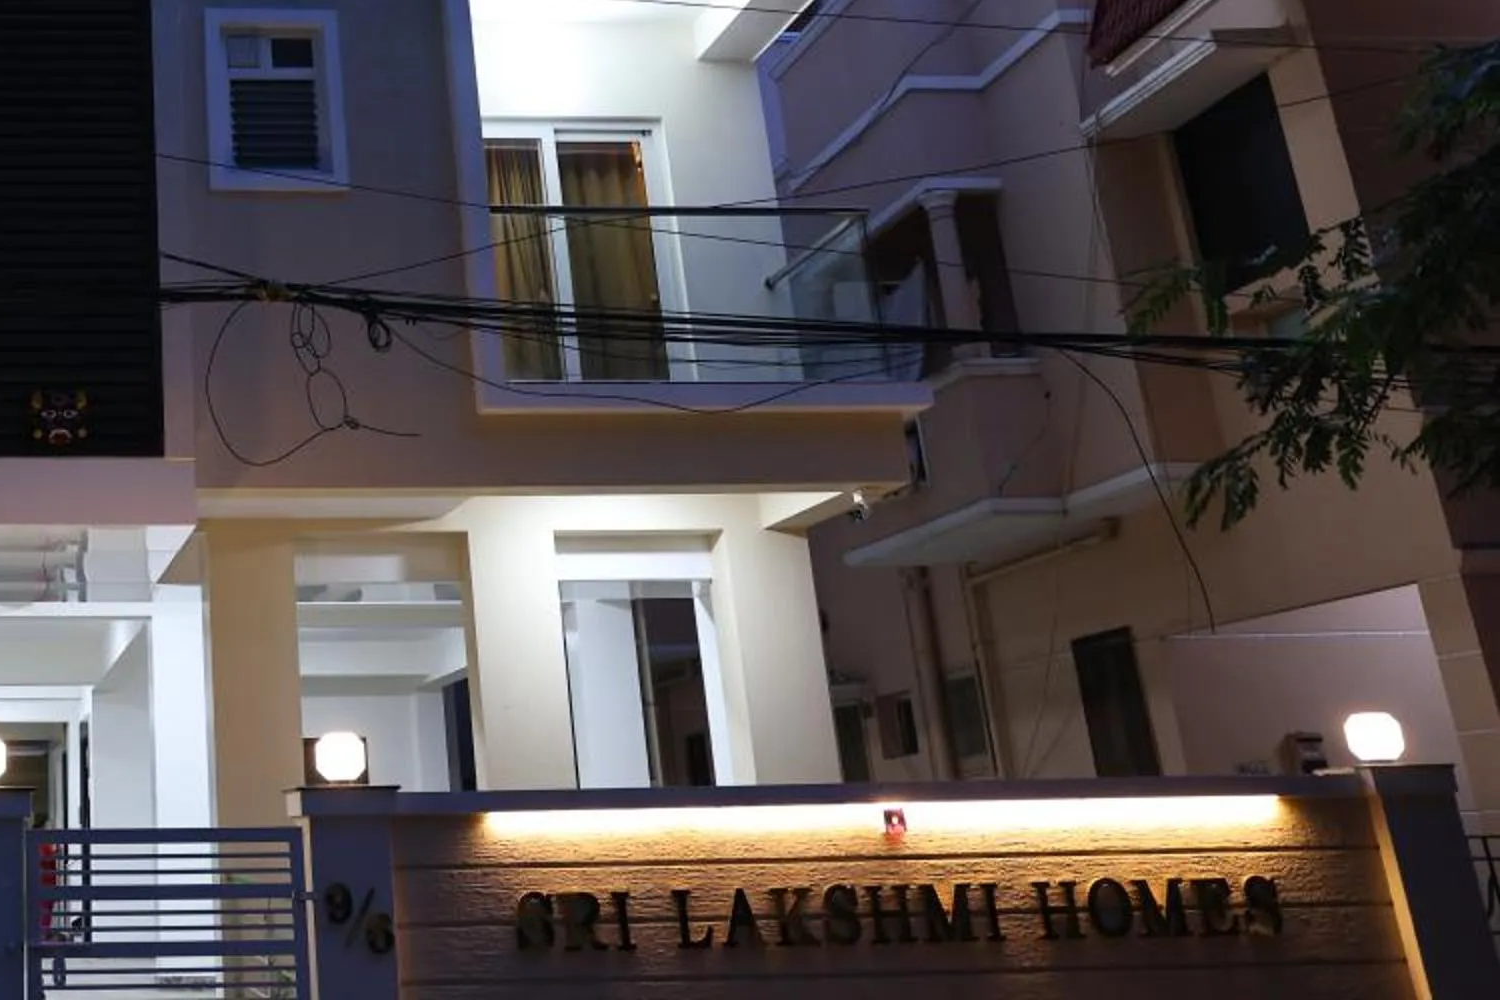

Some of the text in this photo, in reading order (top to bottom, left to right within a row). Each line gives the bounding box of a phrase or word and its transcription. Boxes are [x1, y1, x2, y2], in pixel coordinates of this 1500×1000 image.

[325, 882, 395, 954] 9/6
[516, 876, 1283, 951] SRI LAKSHMI HOMES
